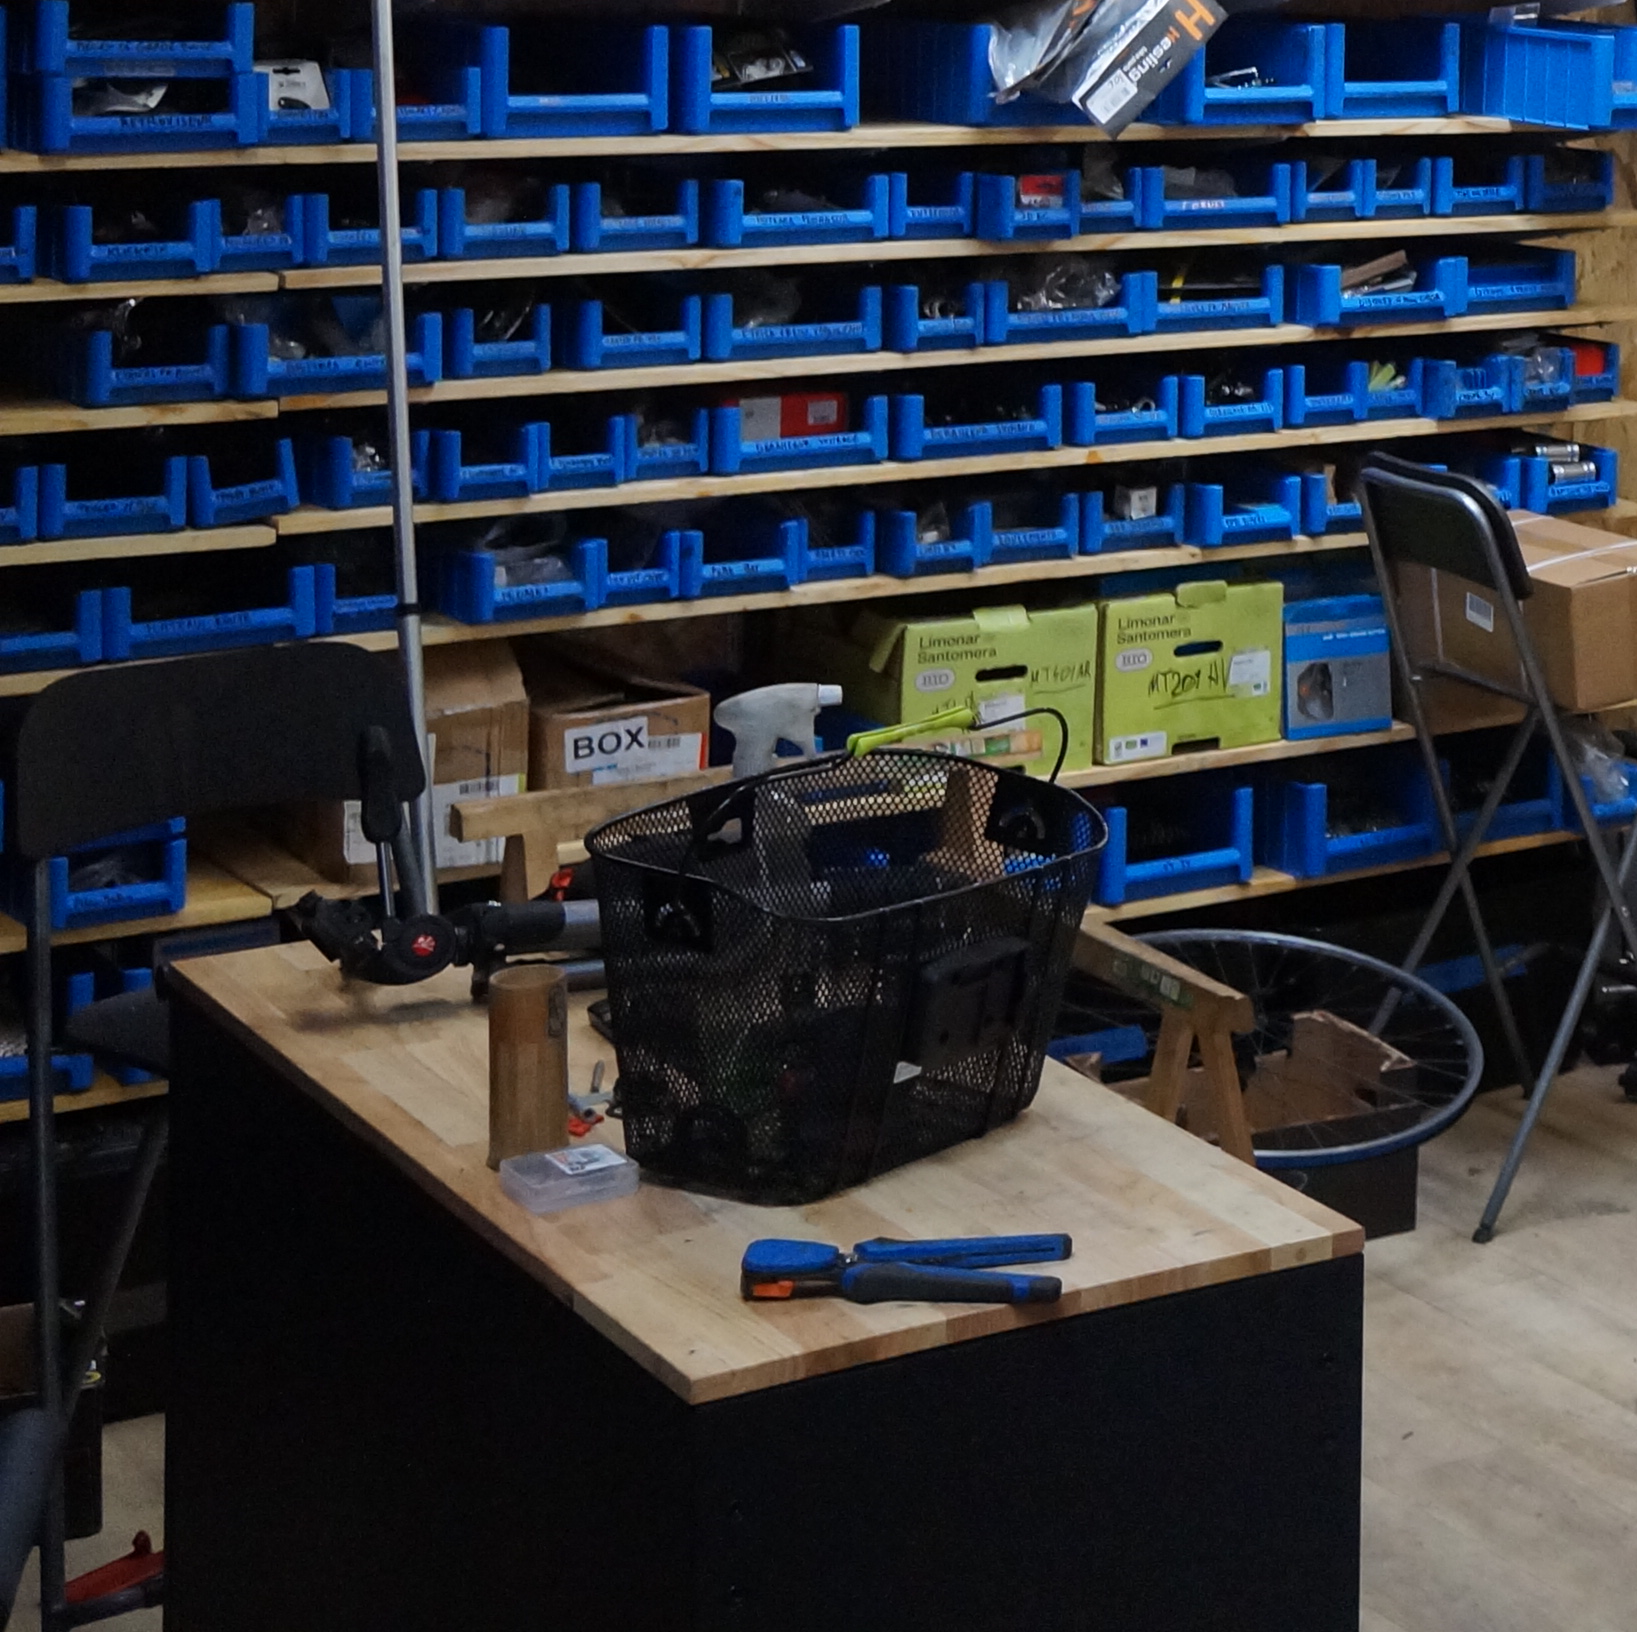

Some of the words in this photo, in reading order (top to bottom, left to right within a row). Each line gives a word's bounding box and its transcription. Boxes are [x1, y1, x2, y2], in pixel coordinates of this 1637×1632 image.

[1118, 614, 1176, 631] Limonar
[919, 633, 981, 650] Limonar
[1116, 626, 1192, 644] Santomera
[917, 647, 998, 664] Santomera
[573, 725, 645, 760] BOX
